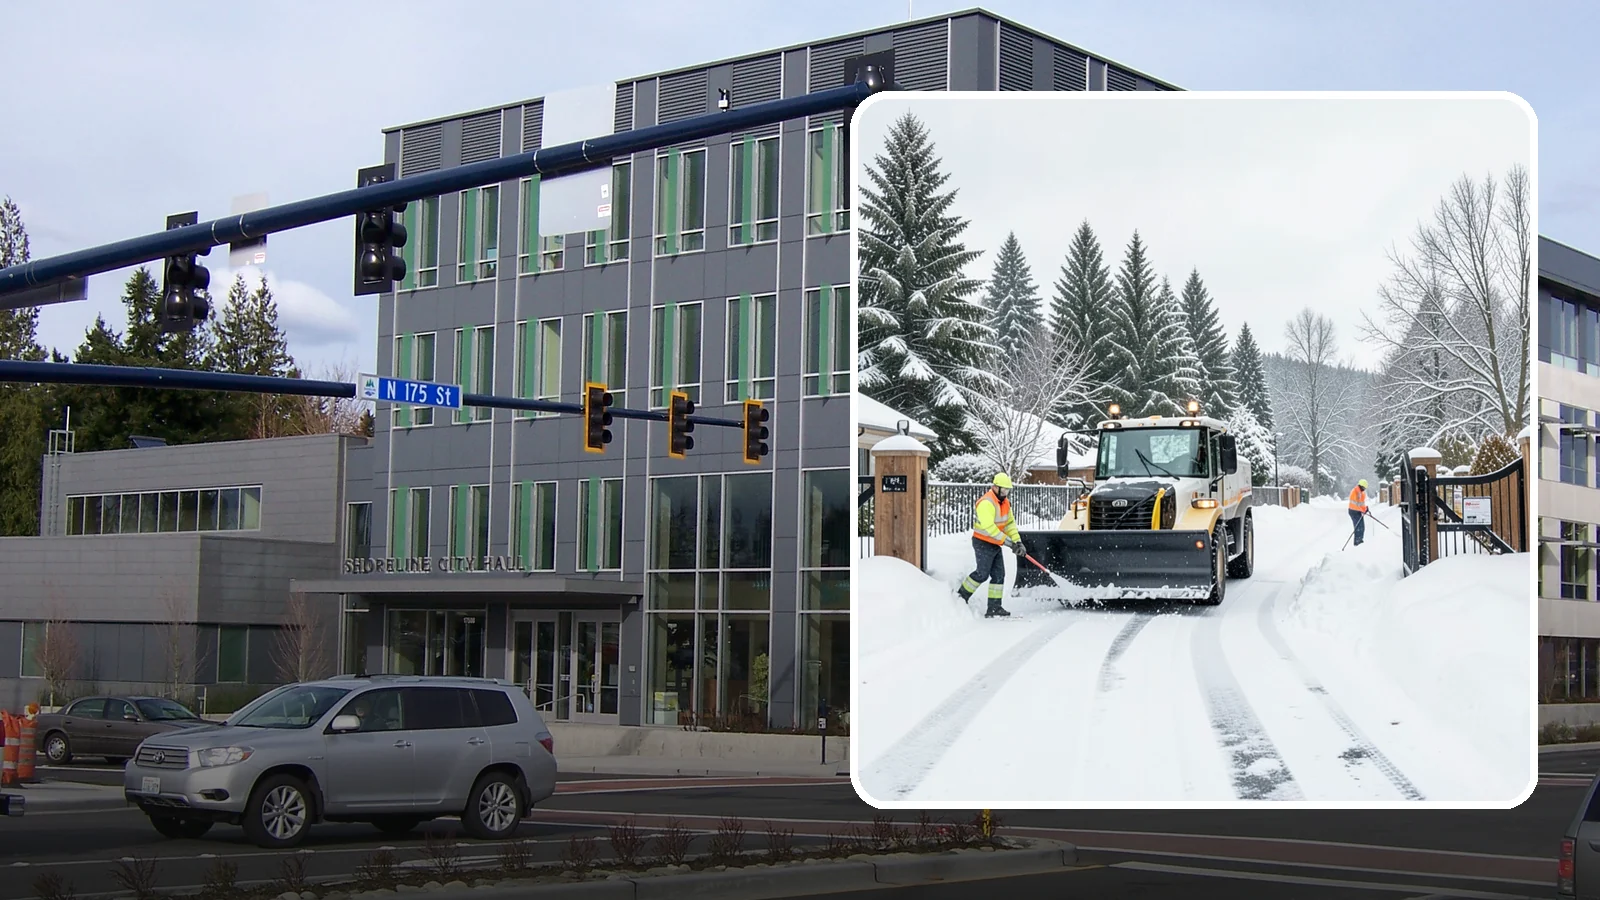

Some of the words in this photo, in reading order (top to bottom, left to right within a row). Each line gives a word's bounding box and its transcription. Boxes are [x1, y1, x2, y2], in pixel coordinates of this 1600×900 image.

[387, 380, 396, 400] N
[405, 382, 428, 403] 175
[436, 386, 451, 406] St
[343, 556, 432, 575] SHORELINE
[438, 556, 476, 573] CITY
[483, 555, 526, 572] HALL
